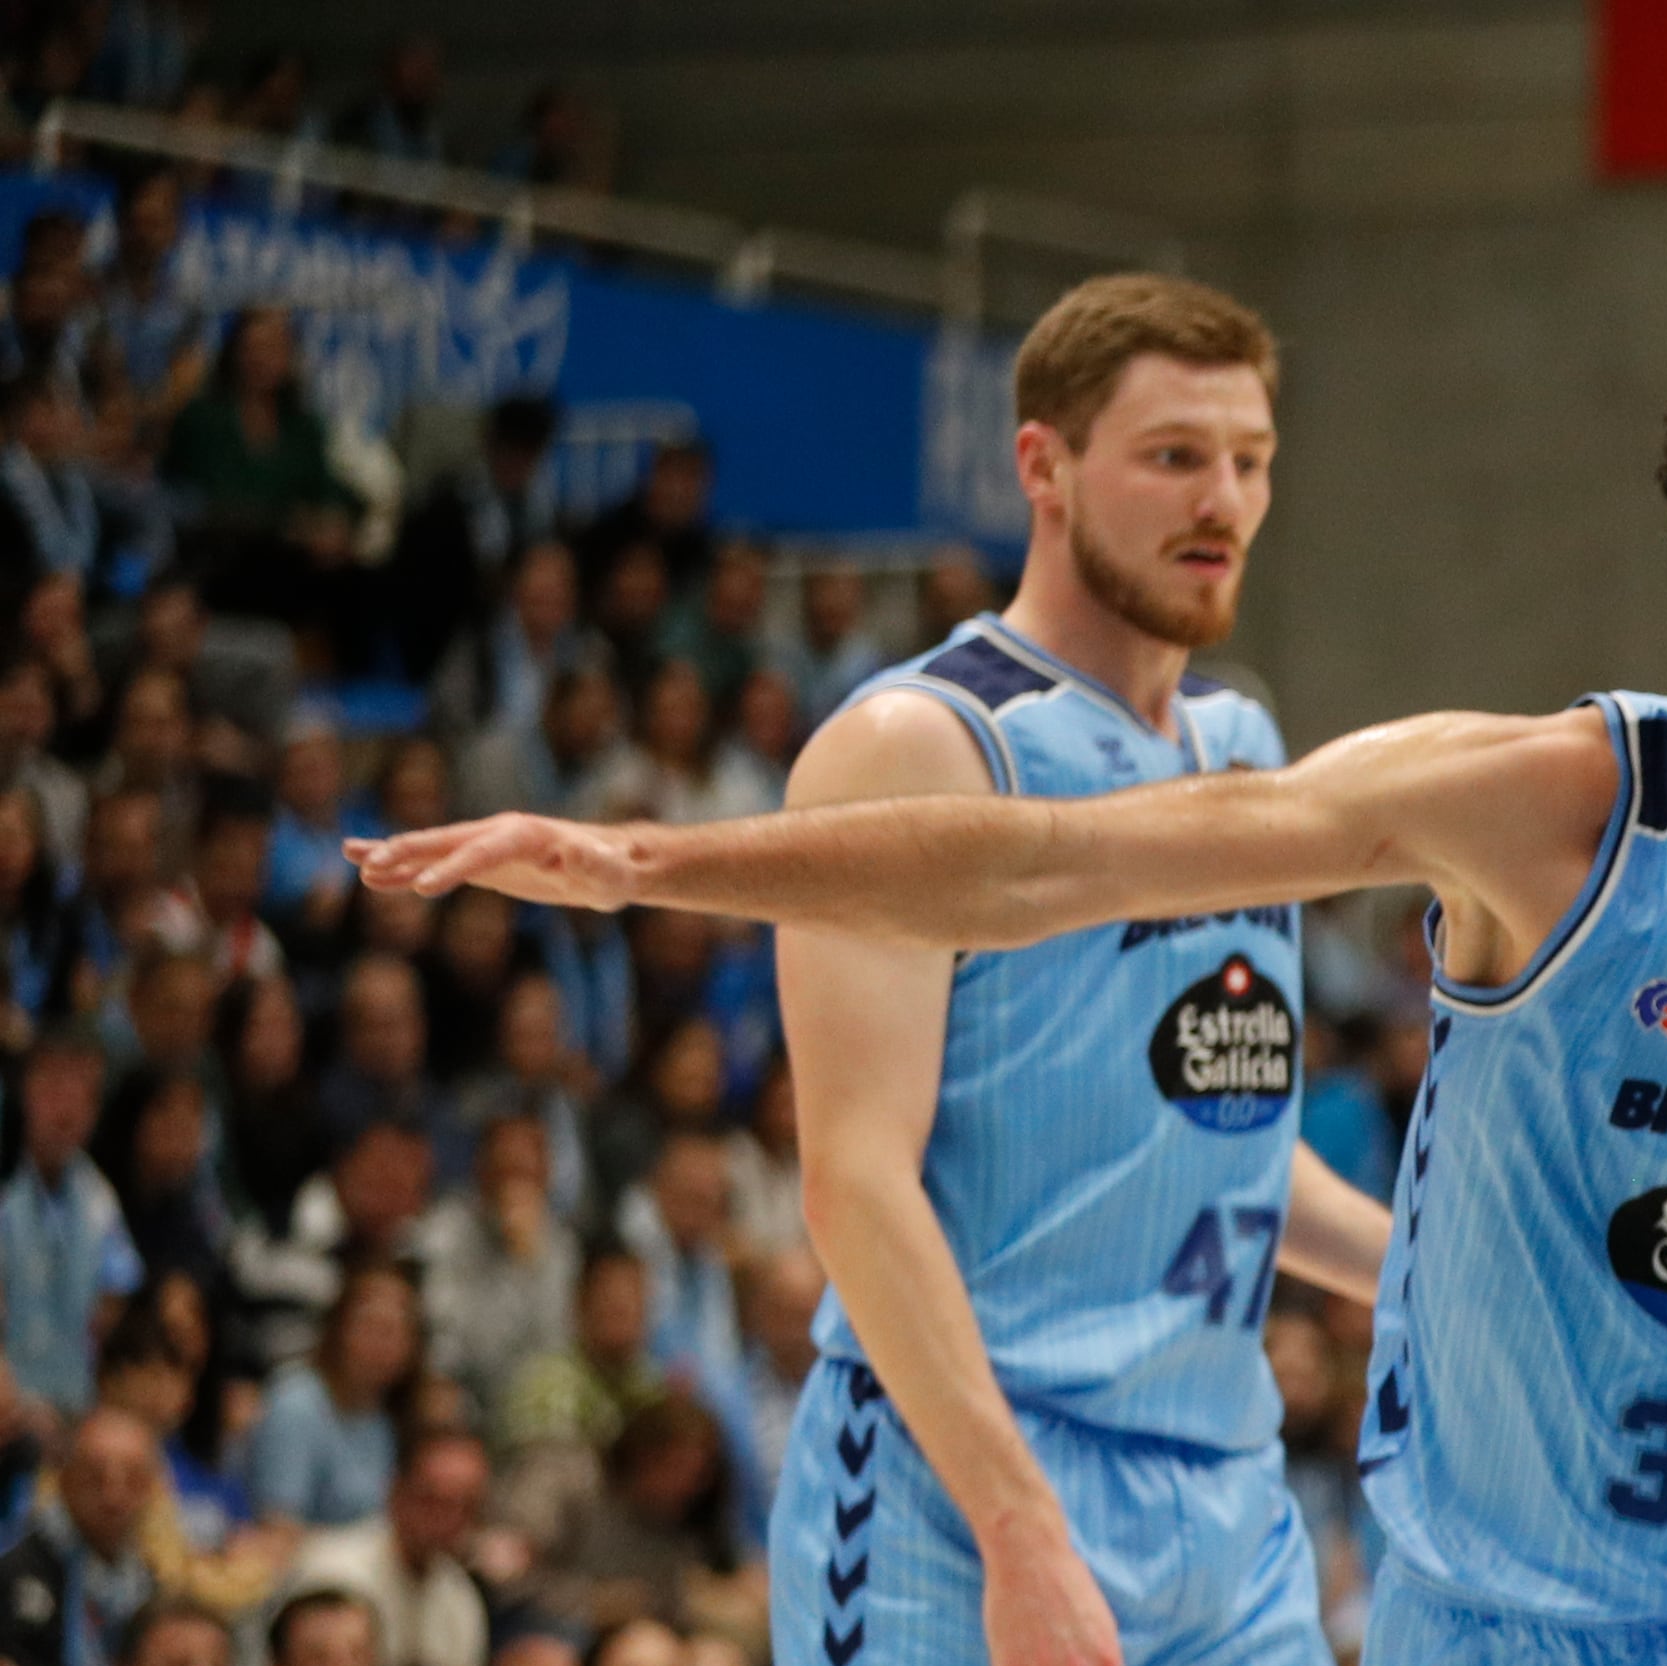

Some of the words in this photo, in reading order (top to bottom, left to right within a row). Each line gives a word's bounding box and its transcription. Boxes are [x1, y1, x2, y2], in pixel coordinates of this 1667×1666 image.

[1177, 1003, 1292, 1049] Estrella
[1182, 1047, 1289, 1091] Galicia
[1162, 1207, 1282, 1330] 47
